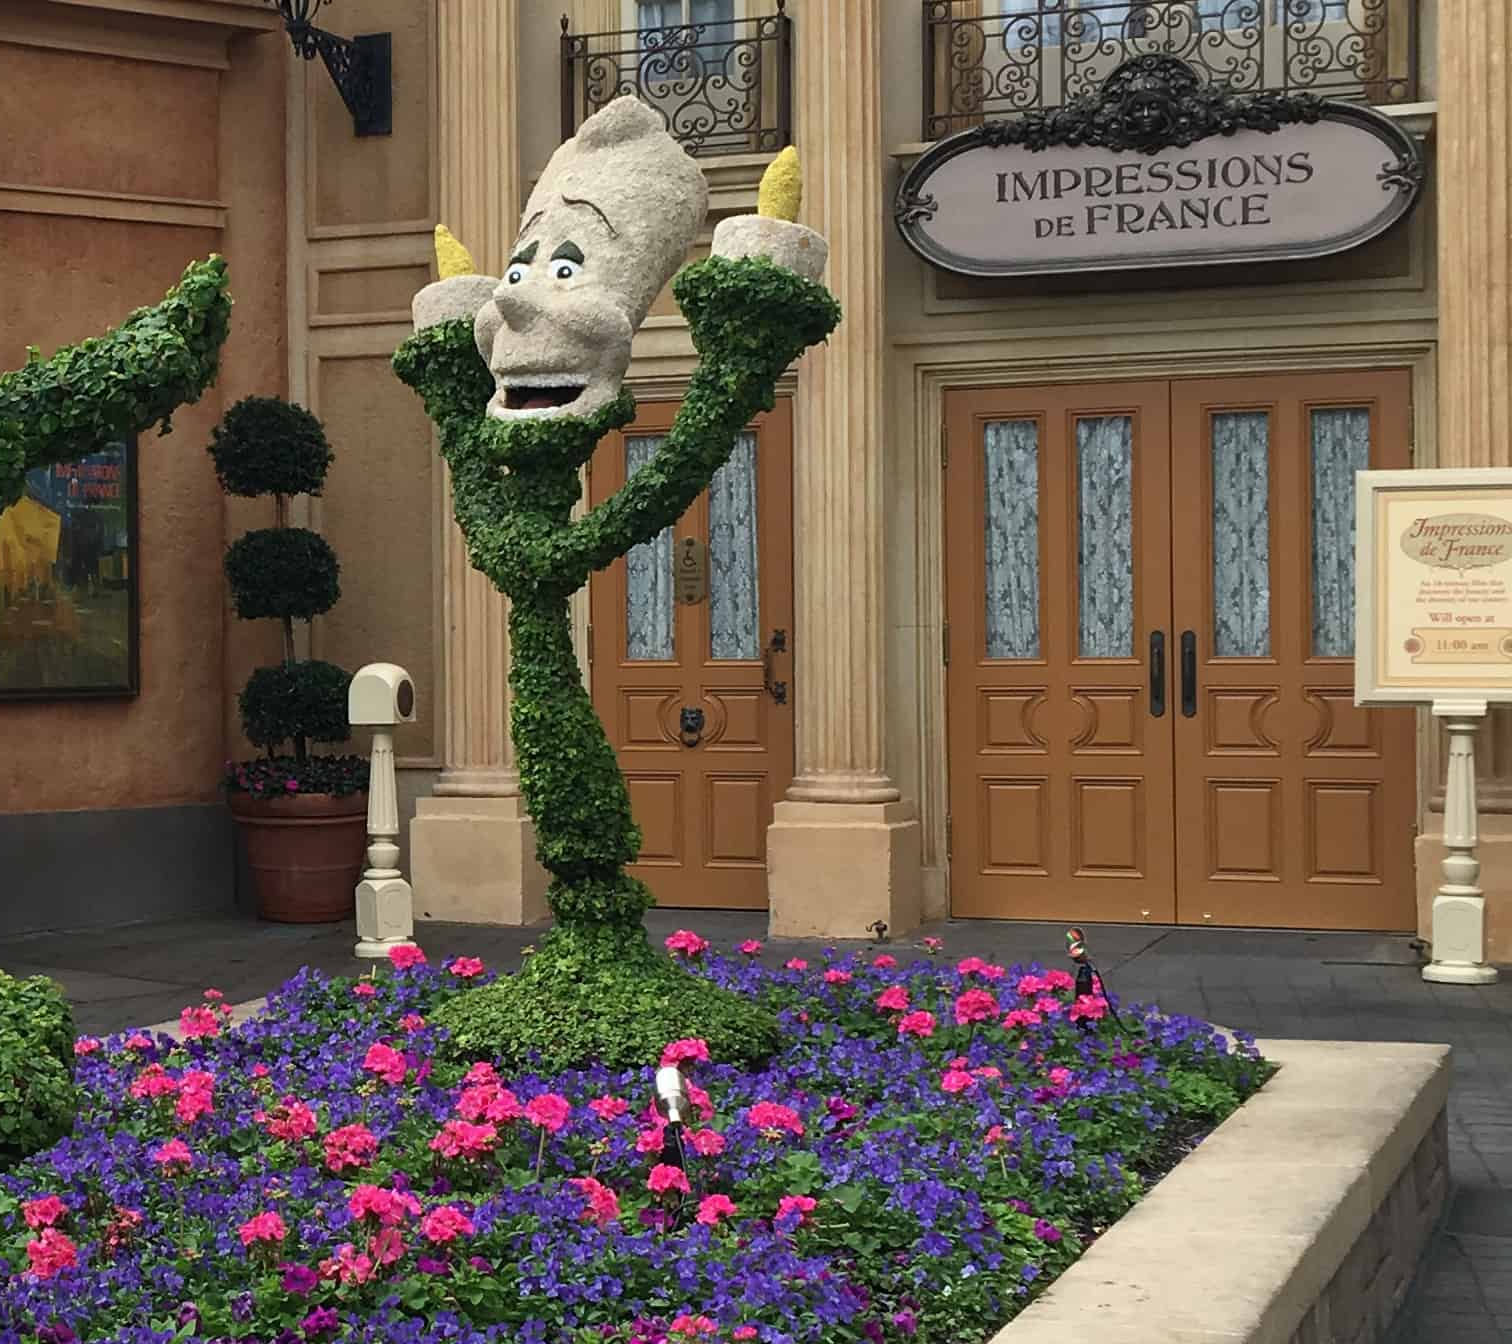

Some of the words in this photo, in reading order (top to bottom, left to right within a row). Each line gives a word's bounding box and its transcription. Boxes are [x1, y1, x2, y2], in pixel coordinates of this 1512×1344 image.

[995, 152, 1315, 204] IMPRESSIONS
[1034, 216, 1076, 239] DE
[1085, 193, 1272, 236] FRANCE
[1419, 541, 1439, 557] de
[1438, 538, 1505, 561] France
